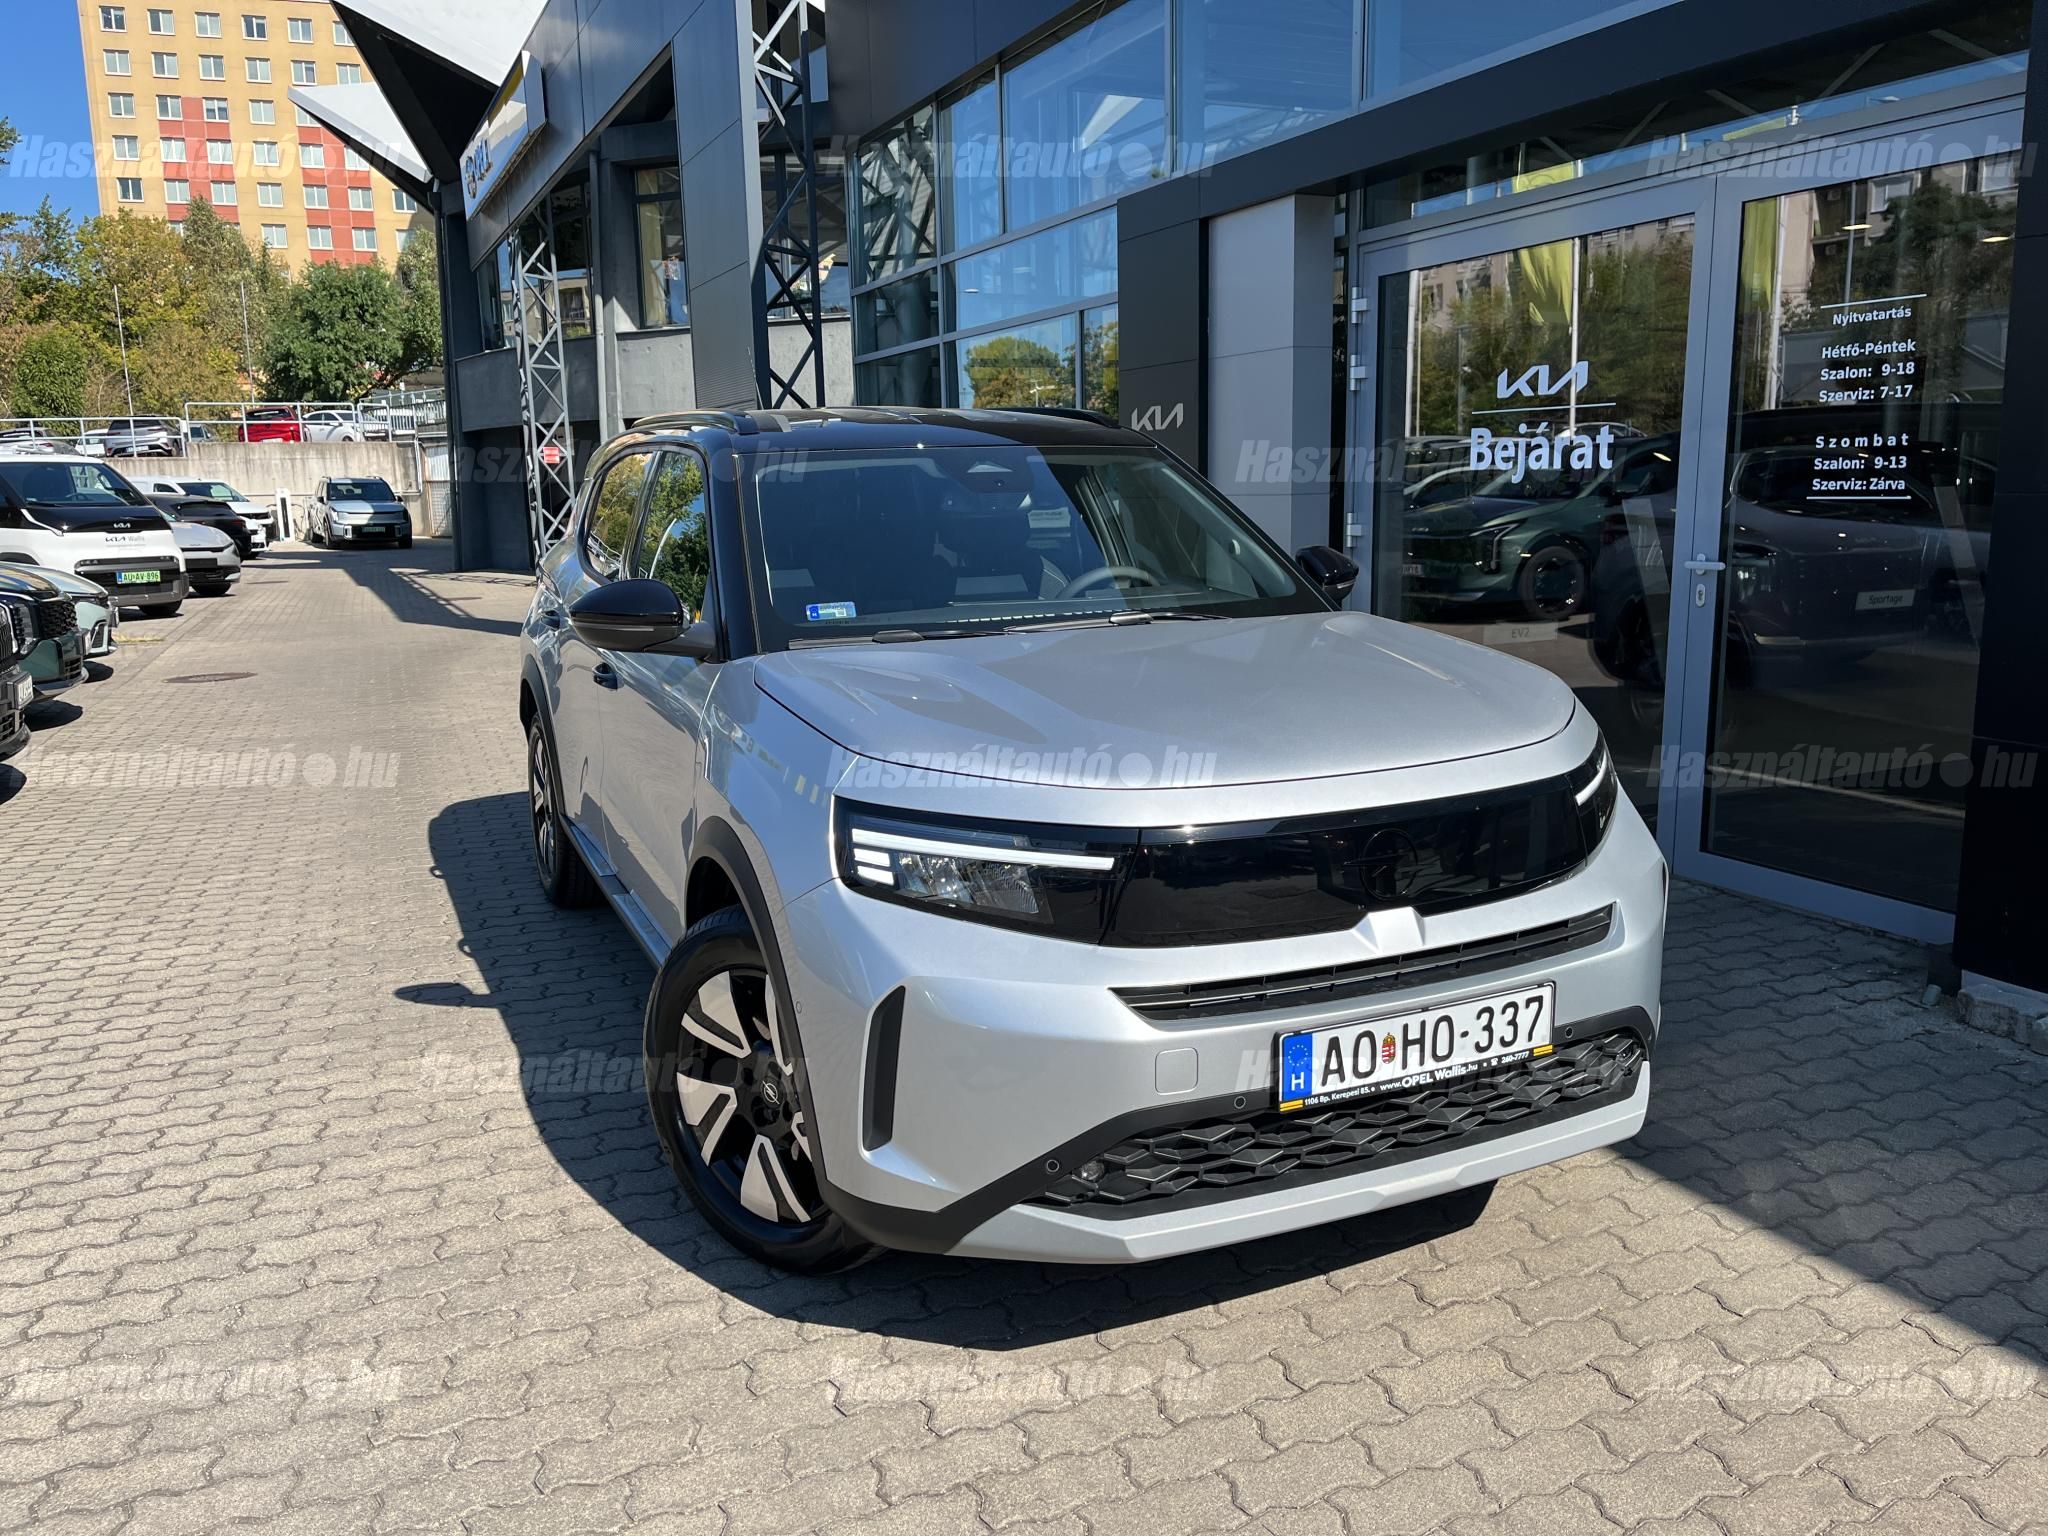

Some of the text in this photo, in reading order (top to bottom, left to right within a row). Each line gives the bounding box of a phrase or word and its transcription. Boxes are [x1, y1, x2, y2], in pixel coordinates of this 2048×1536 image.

[1832, 306, 1912, 326] Nyitvatartás
[1821, 339, 1916, 359] Hétfő-Péntek
[1496, 361, 1589, 399] KIA
[1820, 362, 1915, 381] Szalon: 9-18
[1819, 385, 1913, 402] Szerviz: 7-17
[1131, 402, 1184, 431] KIA
[1469, 422, 1615, 484] Bejárat
[1814, 456, 1907, 470] Szalon: 9-13
[1812, 477, 1905, 491] Szerviz: Zárva
[1511, 627, 1530, 639] EV2
[1291, 1071, 1304, 1092] H
[1304, 1097, 1319, 1106] 1106
[1331, 1088, 1360, 1100] Kerepesi
